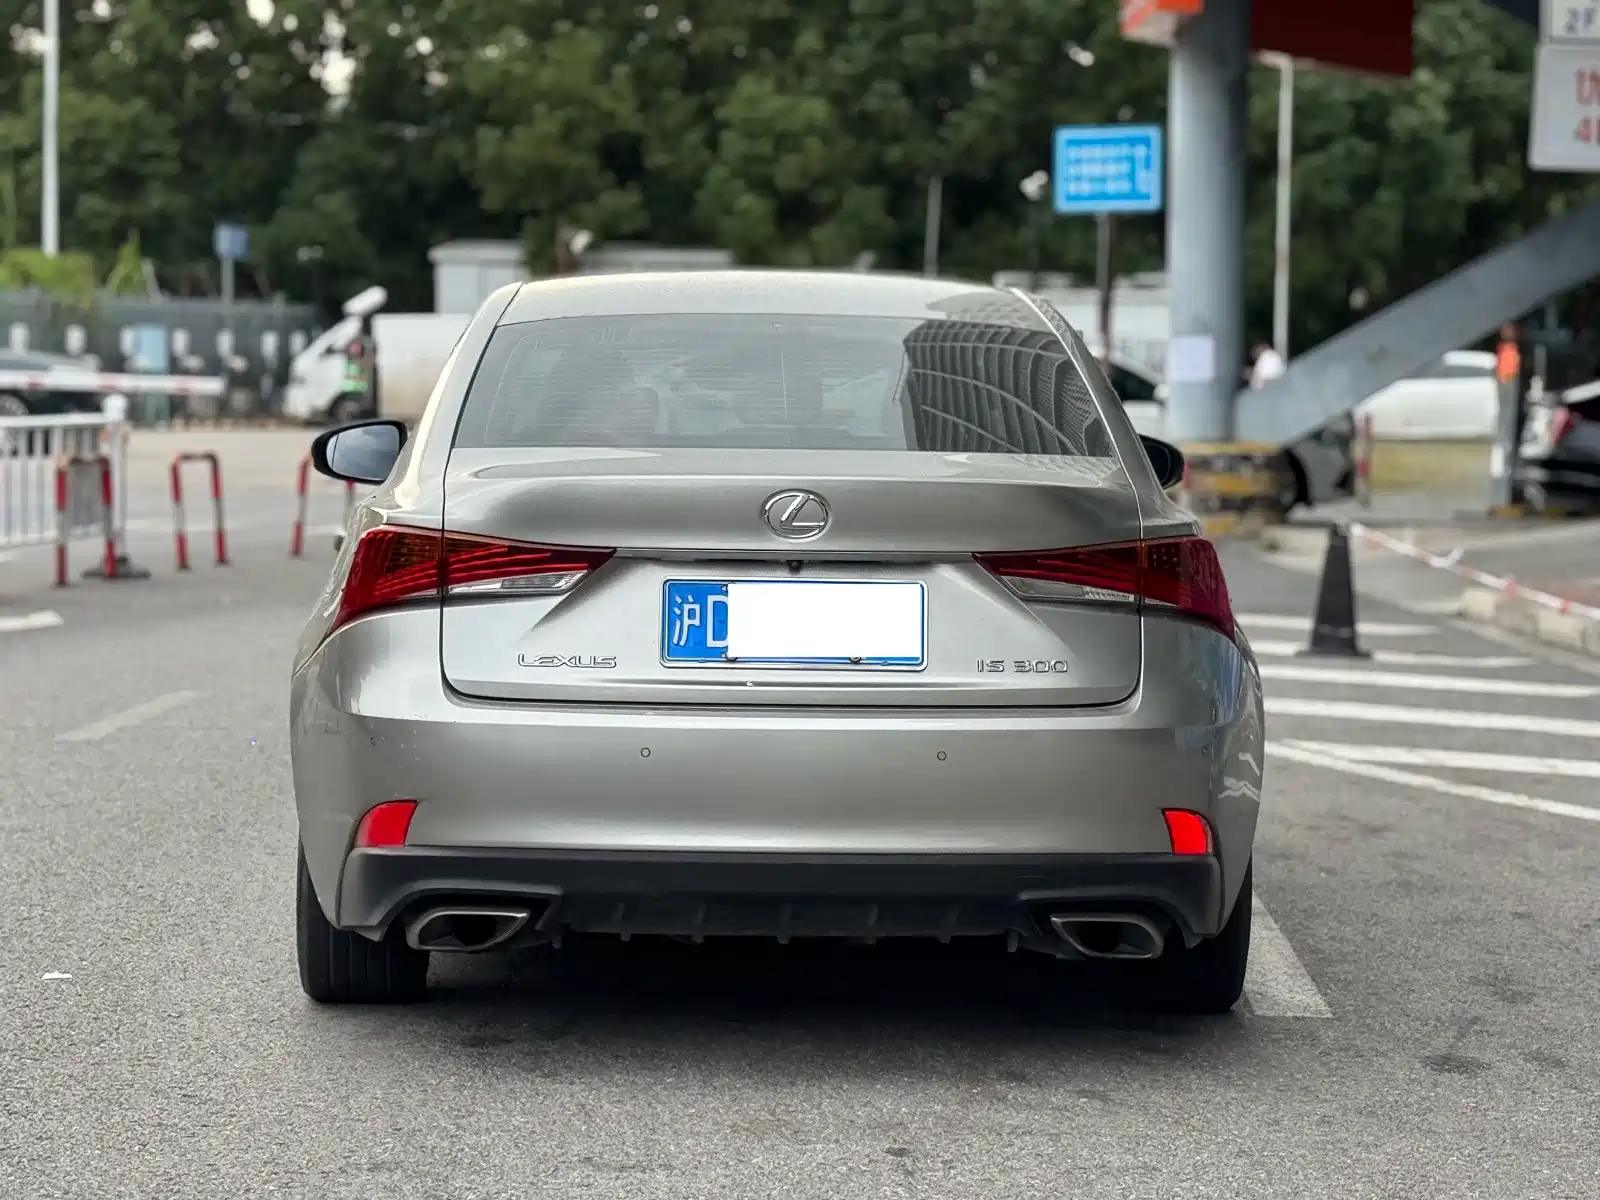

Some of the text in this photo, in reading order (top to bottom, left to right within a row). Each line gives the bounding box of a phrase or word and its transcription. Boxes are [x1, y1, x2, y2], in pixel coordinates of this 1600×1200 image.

[518, 653, 617, 669] LEXUS
[976, 659, 1069, 674] IS 300
